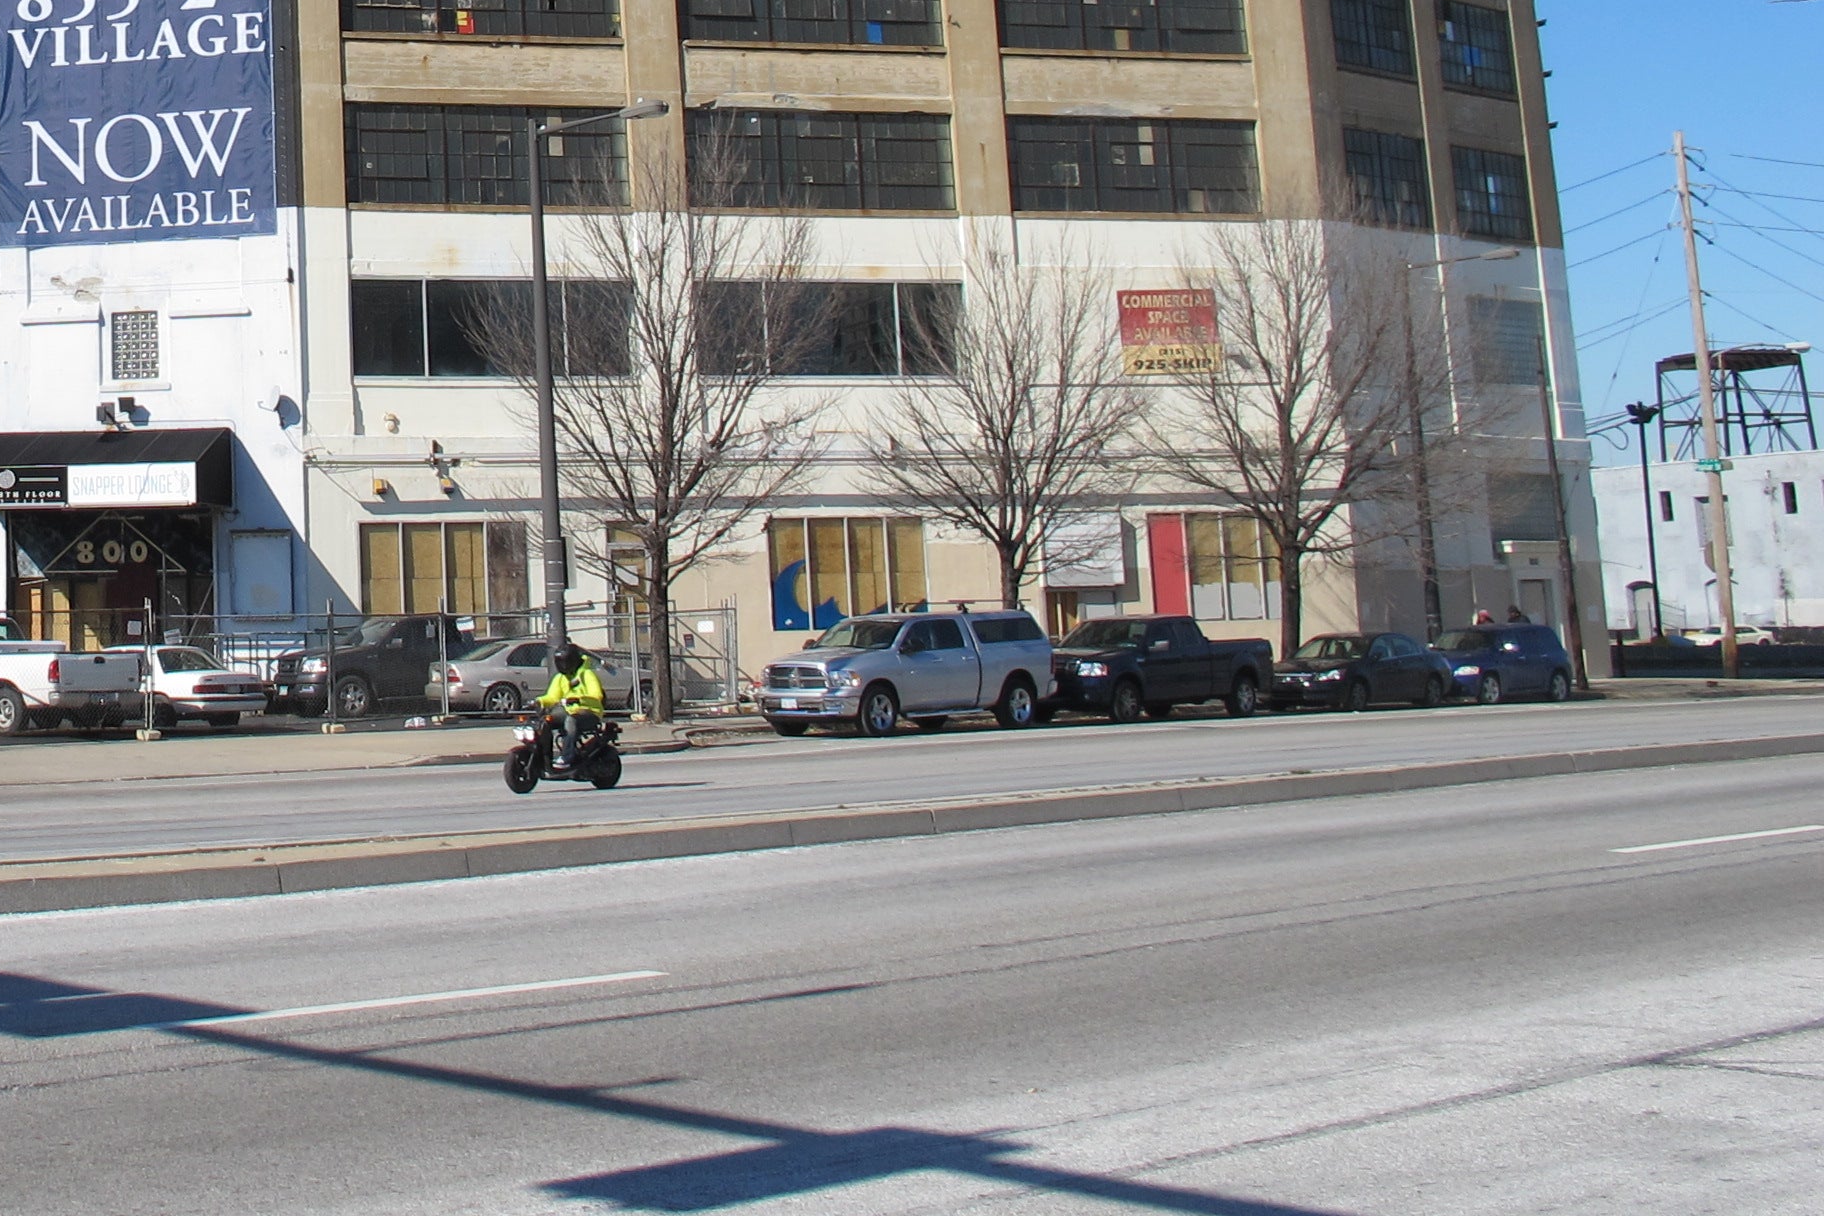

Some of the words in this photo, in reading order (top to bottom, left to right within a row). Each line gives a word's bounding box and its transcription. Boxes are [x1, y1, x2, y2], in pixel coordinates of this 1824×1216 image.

[7, 12, 266, 69] VILLAGE
[22, 107, 252, 186] NOW
[16, 188, 255, 234] AVAILABLE
[1122, 294, 1212, 309] COMMERCIAL
[1147, 310, 1190, 324] SPACE
[25, 490, 61, 498] FLOOR
[72, 474, 125, 496] SNAPPER
[129, 473, 173, 495] LOUNGE
[77, 540, 148, 564] 800
